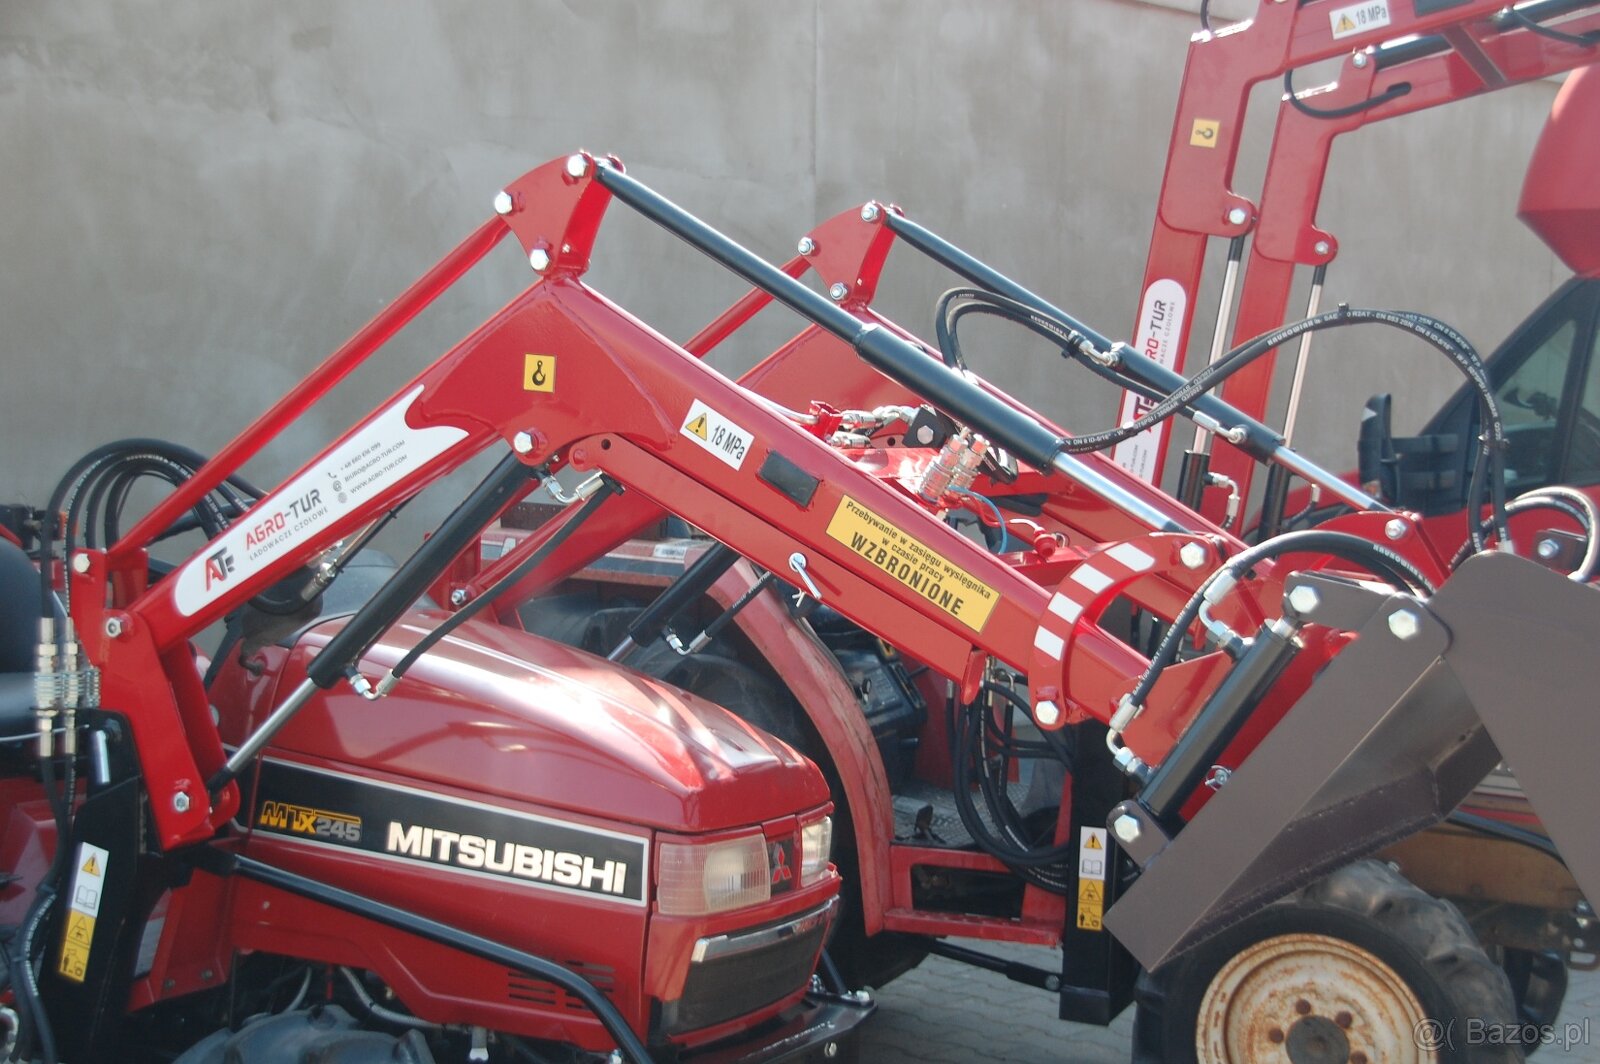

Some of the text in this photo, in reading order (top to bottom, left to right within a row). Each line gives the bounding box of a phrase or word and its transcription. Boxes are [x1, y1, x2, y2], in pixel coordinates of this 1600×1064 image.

[1356, 5, 1387, 24] 18 MPa
[1145, 299, 1166, 360] RO-TUR
[711, 424, 746, 461] 18 MPa
[245, 486, 323, 552] AGRO-TUR
[846, 501, 991, 600] Przebywanie w zasięgu wysięgnika
[850, 530, 965, 616] WZBRONIONE
[882, 537, 945, 583] w czasie pracy
[386, 820, 628, 895] MITSUBISHI
